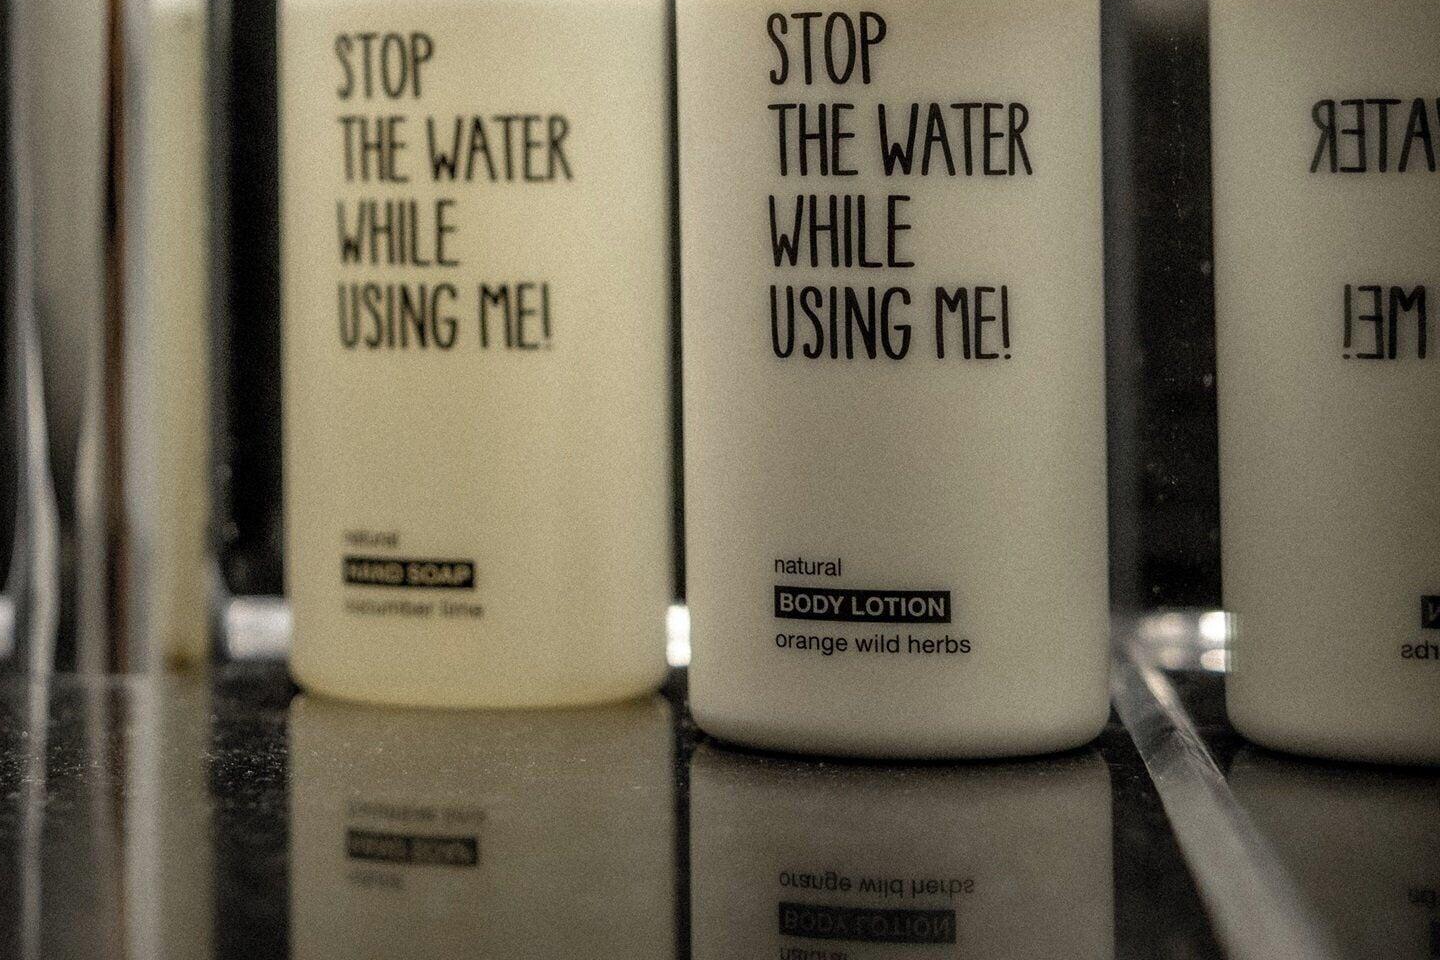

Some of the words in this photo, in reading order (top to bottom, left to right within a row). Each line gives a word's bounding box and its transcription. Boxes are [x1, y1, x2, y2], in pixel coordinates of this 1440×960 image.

[335, 31, 435, 100] STOP
[766, 11, 887, 86] STOP
[338, 115, 409, 184] THE
[427, 114, 574, 183] WATER
[767, 102, 859, 177] THE
[877, 102, 1034, 177] WATER
[337, 199, 461, 268] WHILE
[768, 194, 916, 269] WHILE
[338, 283, 459, 351] USING
[479, 282, 553, 352] ME!
[770, 285, 912, 361] USING
[935, 285, 1012, 360] ME!
[407, 561, 471, 587] SOAP
[774, 557, 842, 577] natural
[779, 592, 845, 615] BODY
[851, 596, 946, 618] LOTION
[775, 633, 849, 657] orange
[854, 634, 900, 654] wild
[907, 634, 972, 655] herbs
